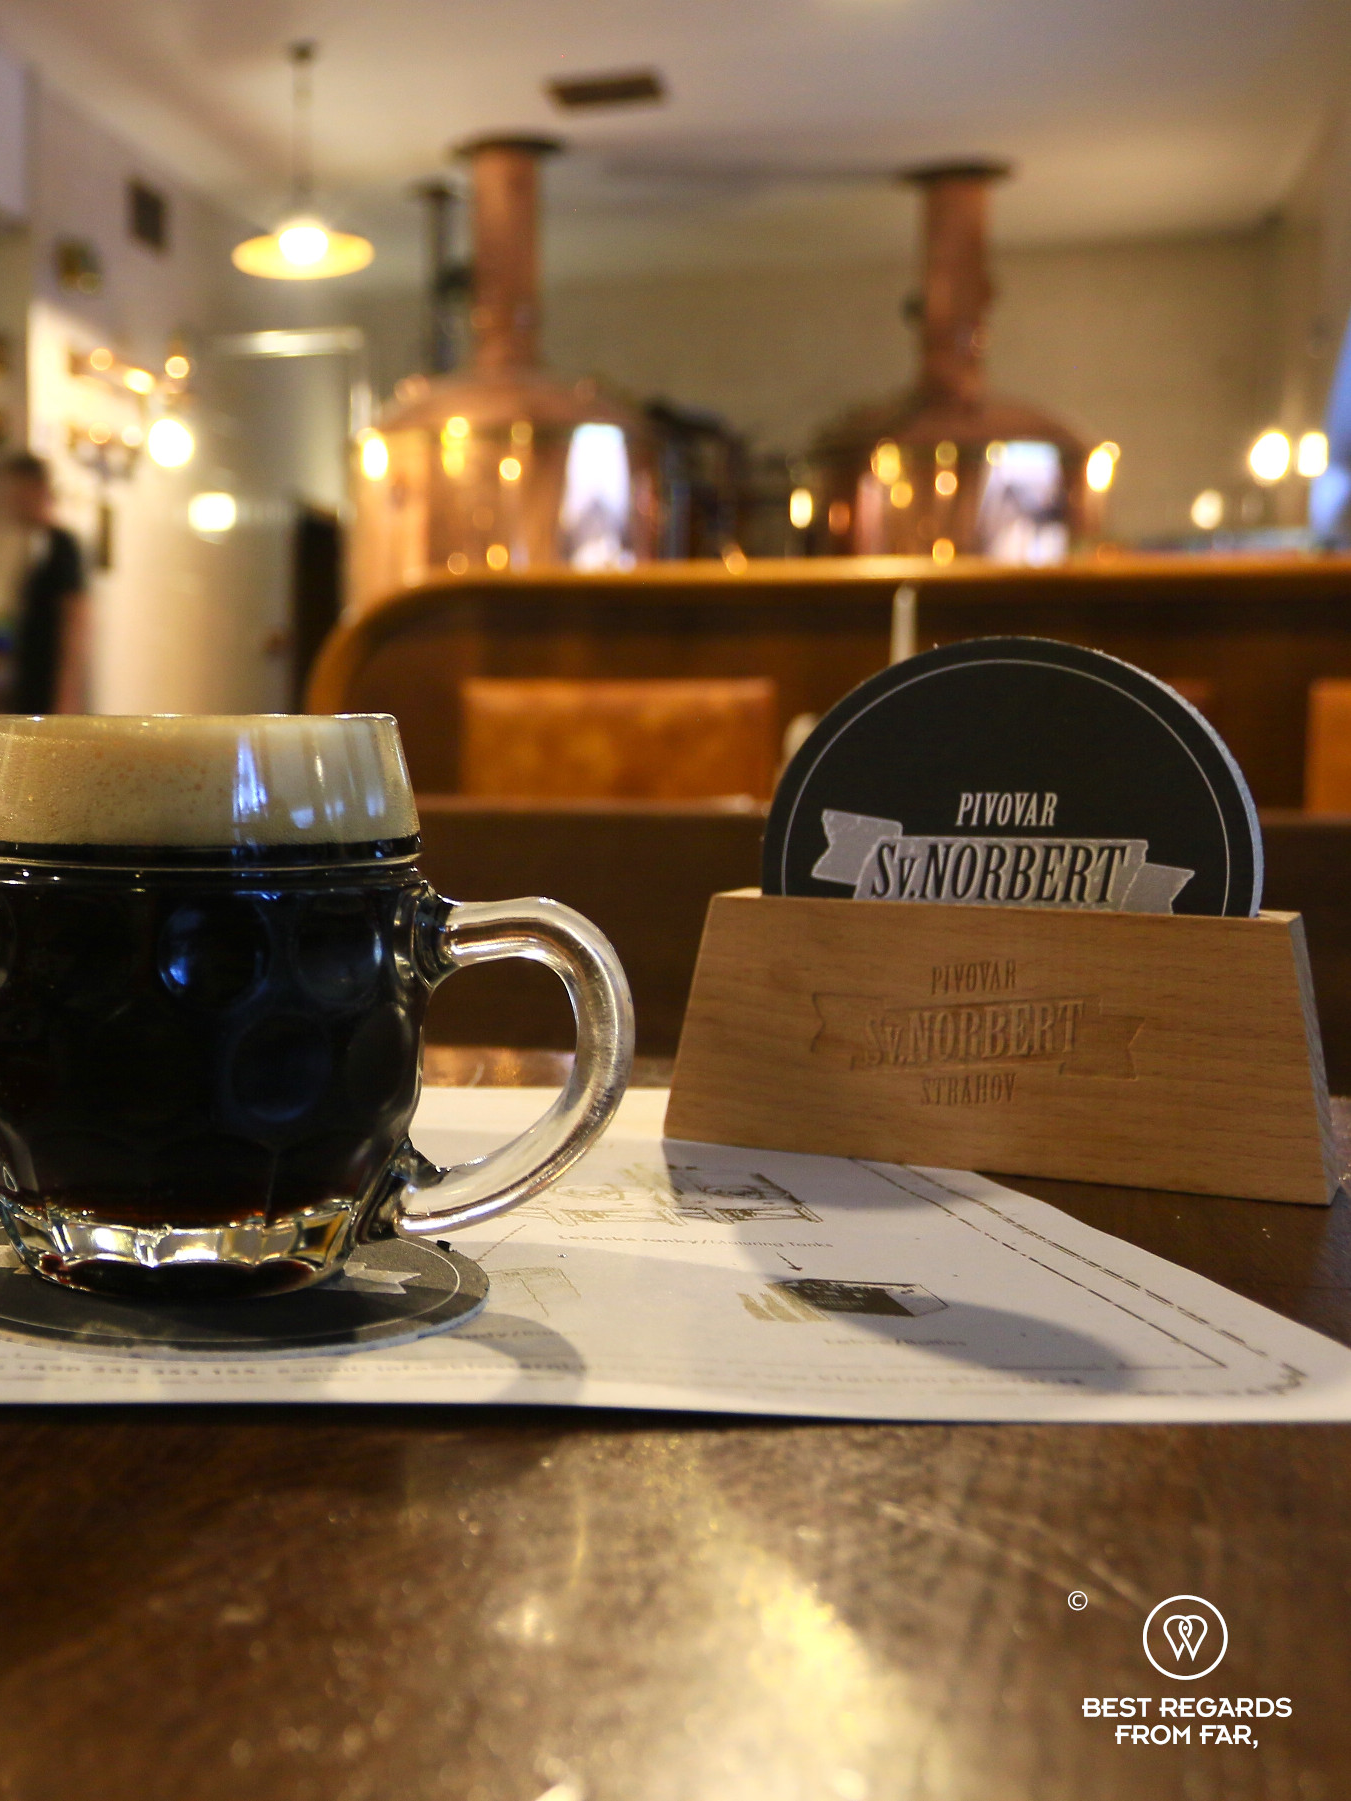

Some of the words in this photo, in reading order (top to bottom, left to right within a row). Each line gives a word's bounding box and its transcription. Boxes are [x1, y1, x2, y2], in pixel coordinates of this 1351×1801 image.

[954, 791, 1058, 827] PIVOVAR
[930, 959, 1017, 996] PIVOVAR
[920, 1072, 1017, 1106] STRAHOV
